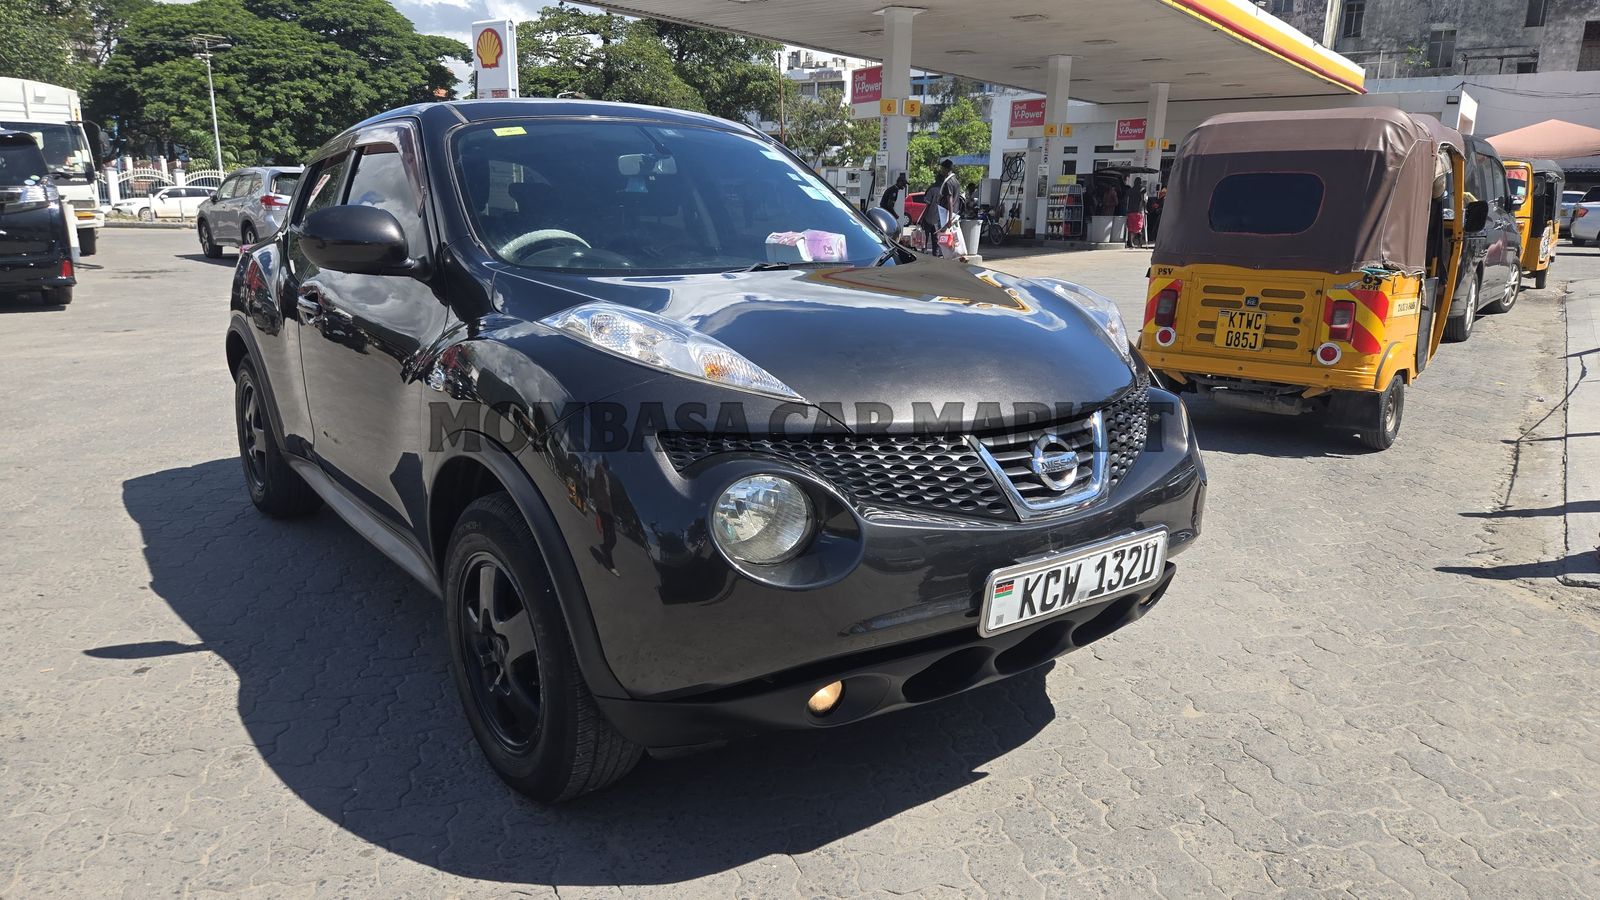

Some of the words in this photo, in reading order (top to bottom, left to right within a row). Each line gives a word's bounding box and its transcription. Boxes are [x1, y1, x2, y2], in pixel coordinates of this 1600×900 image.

[855, 82, 882, 94] V-Power
[886, 103, 892, 112] 6
[909, 103, 915, 112] 5
[1014, 110, 1043, 119] V-Power
[1157, 267, 1174, 275] PSV
[1228, 311, 1263, 330] KTWC
[1019, 563, 1082, 619] KCW
